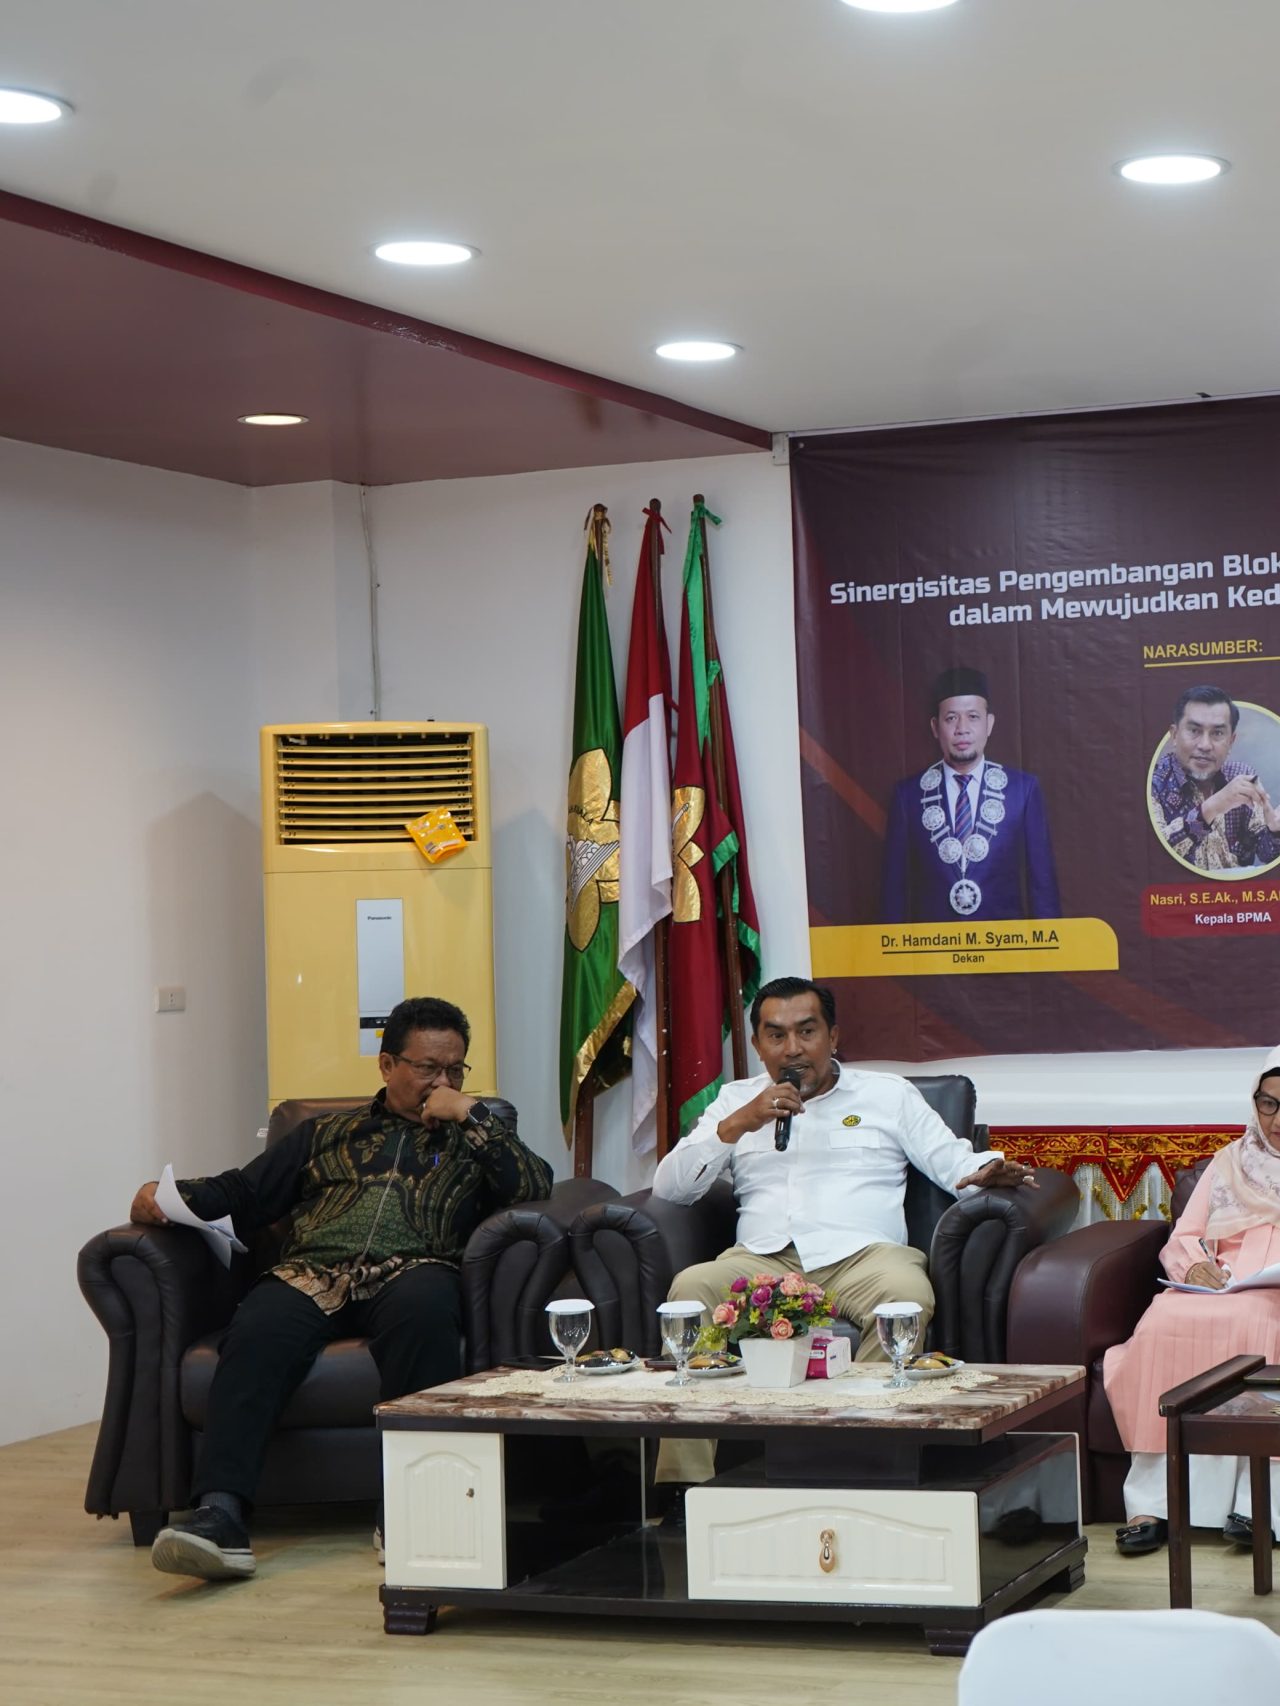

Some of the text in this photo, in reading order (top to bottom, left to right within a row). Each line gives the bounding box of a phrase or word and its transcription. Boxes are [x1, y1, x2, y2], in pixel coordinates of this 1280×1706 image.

[831, 575, 991, 603] Sinergisitas
[1000, 562, 1213, 593] Pengembangan
[950, 603, 1032, 625] dalam
[1042, 591, 1218, 619] Mewujudkan
[1144, 640, 1262, 658] NARASUMBER:
[1151, 894, 1185, 905] Nasri,
[1190, 892, 1237, 903] S.E.Ak.,
[1195, 912, 1271, 925] Kepala BPMA
[882, 930, 1058, 947] Dr. Hamdani M. Syam, M.A
[953, 954, 984, 963] Dekan
